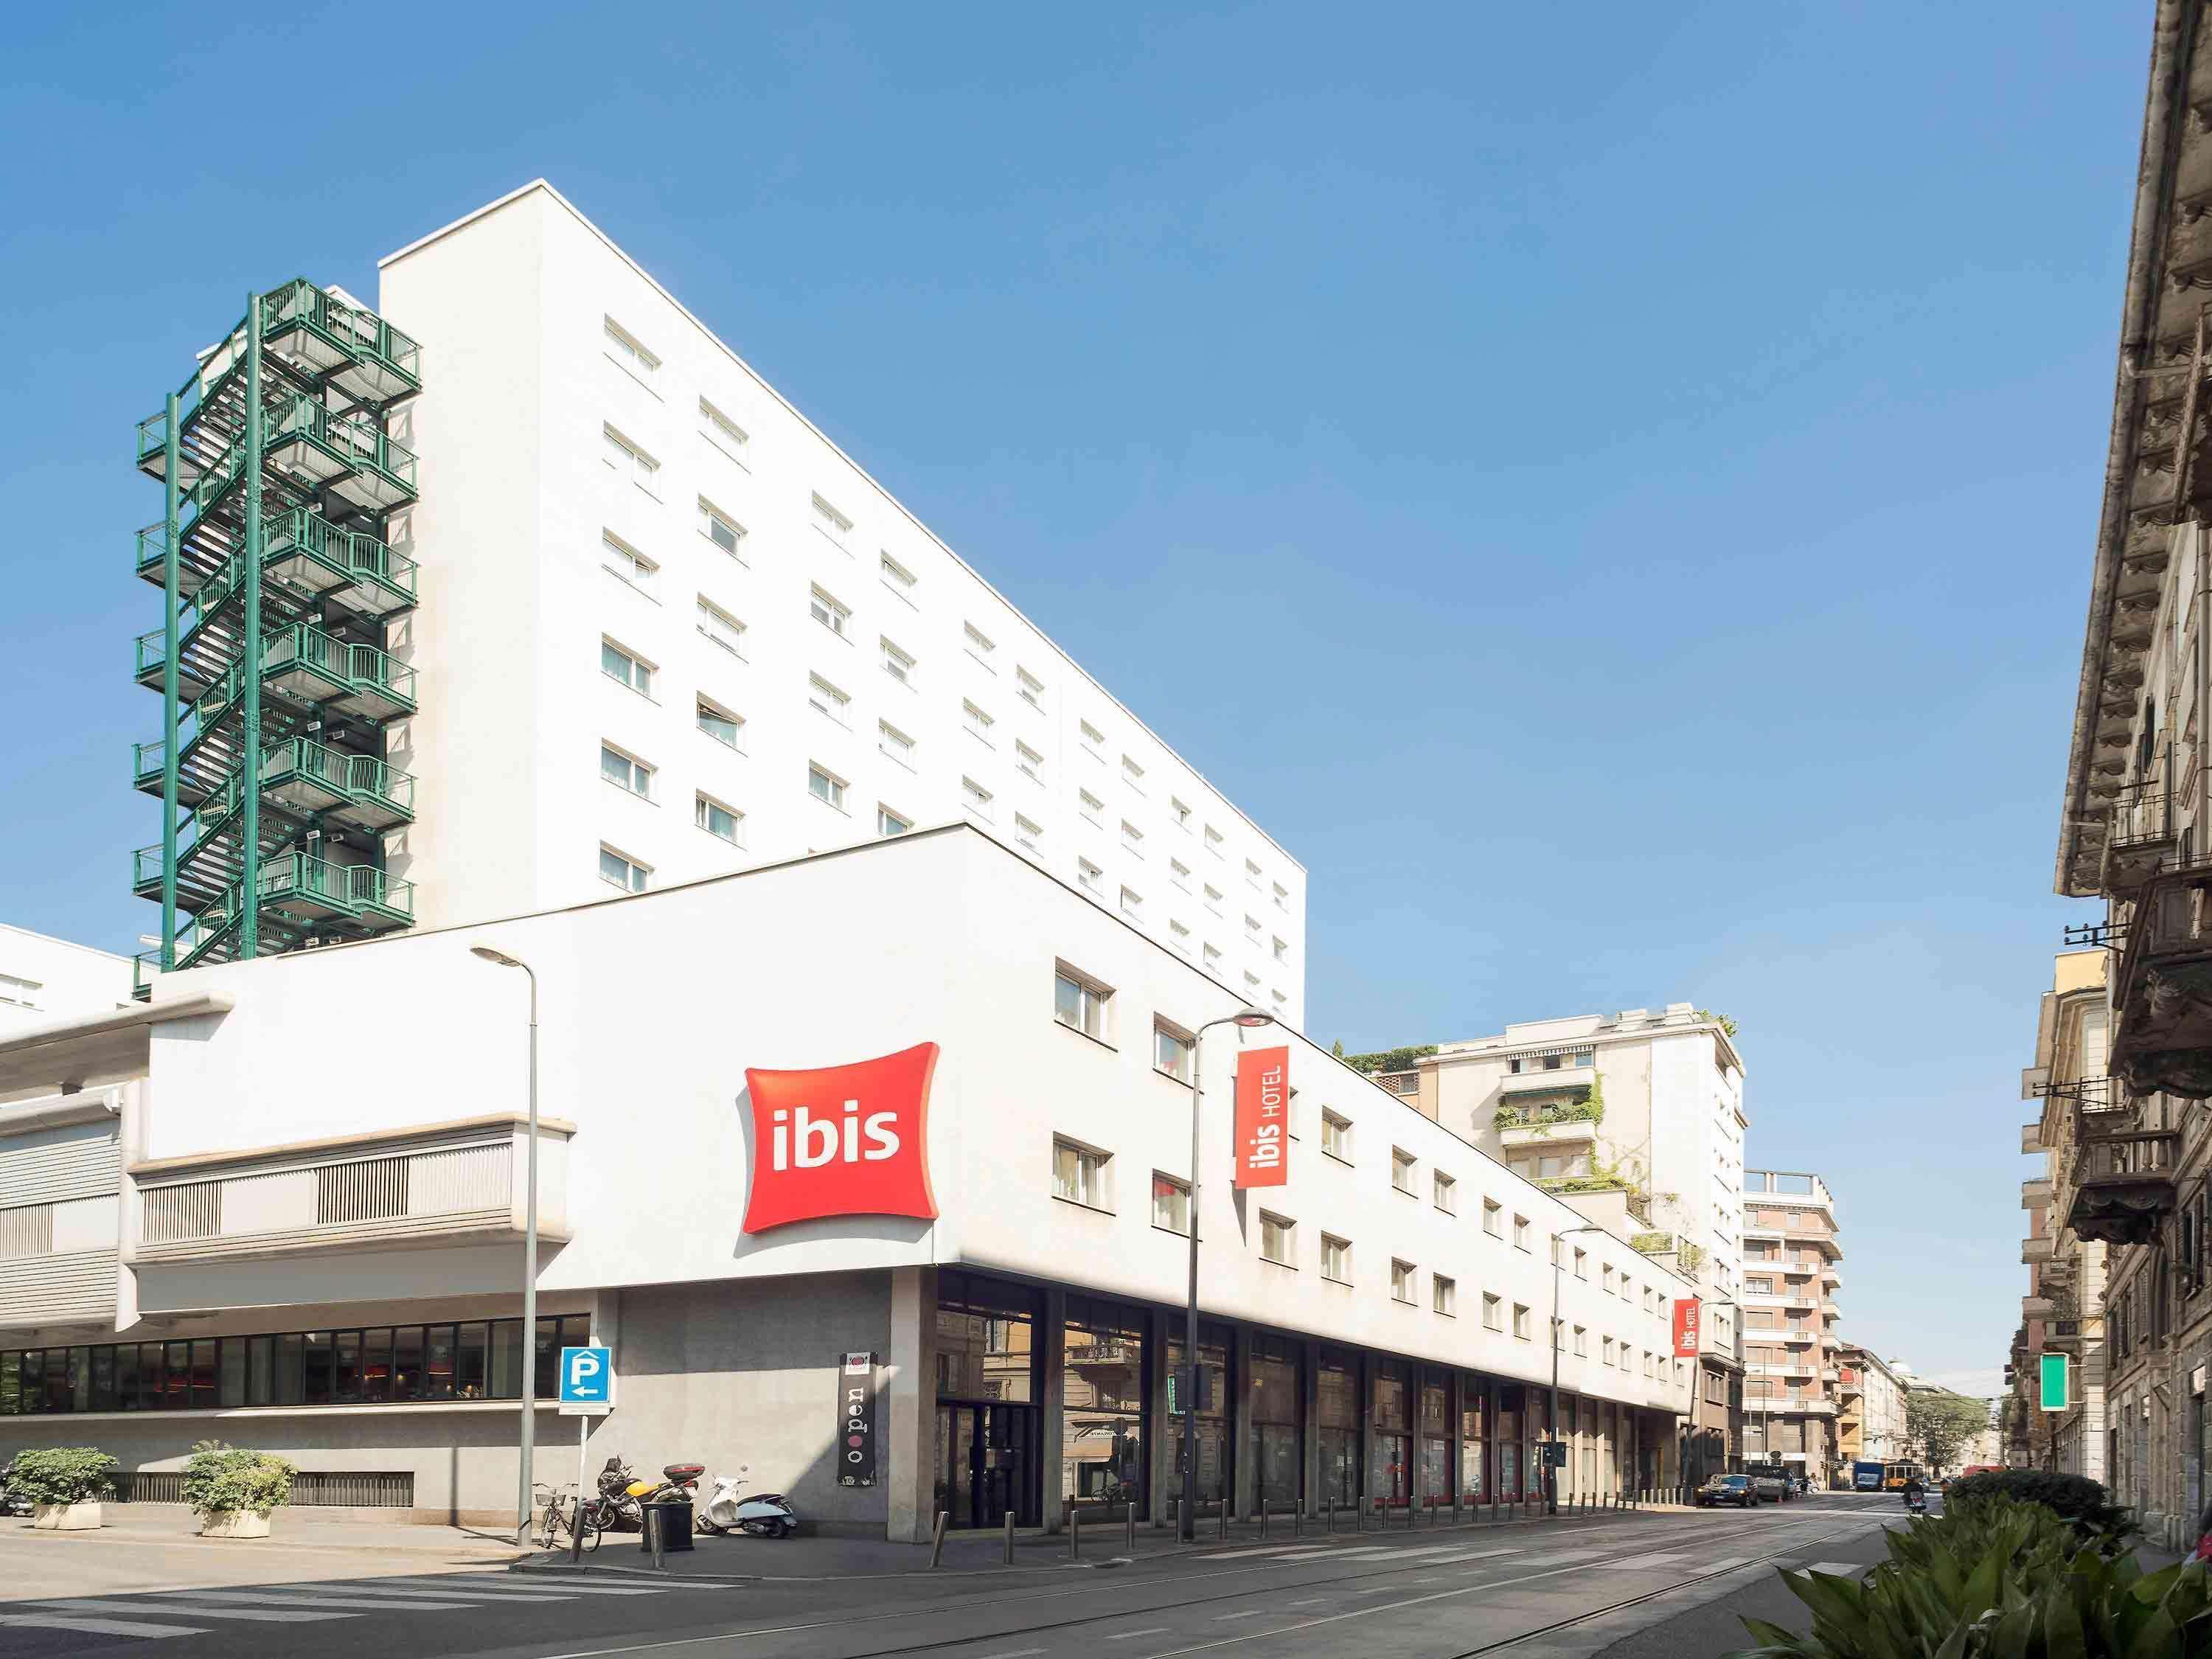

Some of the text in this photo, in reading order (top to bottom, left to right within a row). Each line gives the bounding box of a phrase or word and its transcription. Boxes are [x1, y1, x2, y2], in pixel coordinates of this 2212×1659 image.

[773, 1099, 900, 1172] ibis
[1249, 1064, 1281, 1169] ibis HOTEL
[1680, 1307, 1696, 1350] ibis HOTEL
[571, 1357, 599, 1385] P
